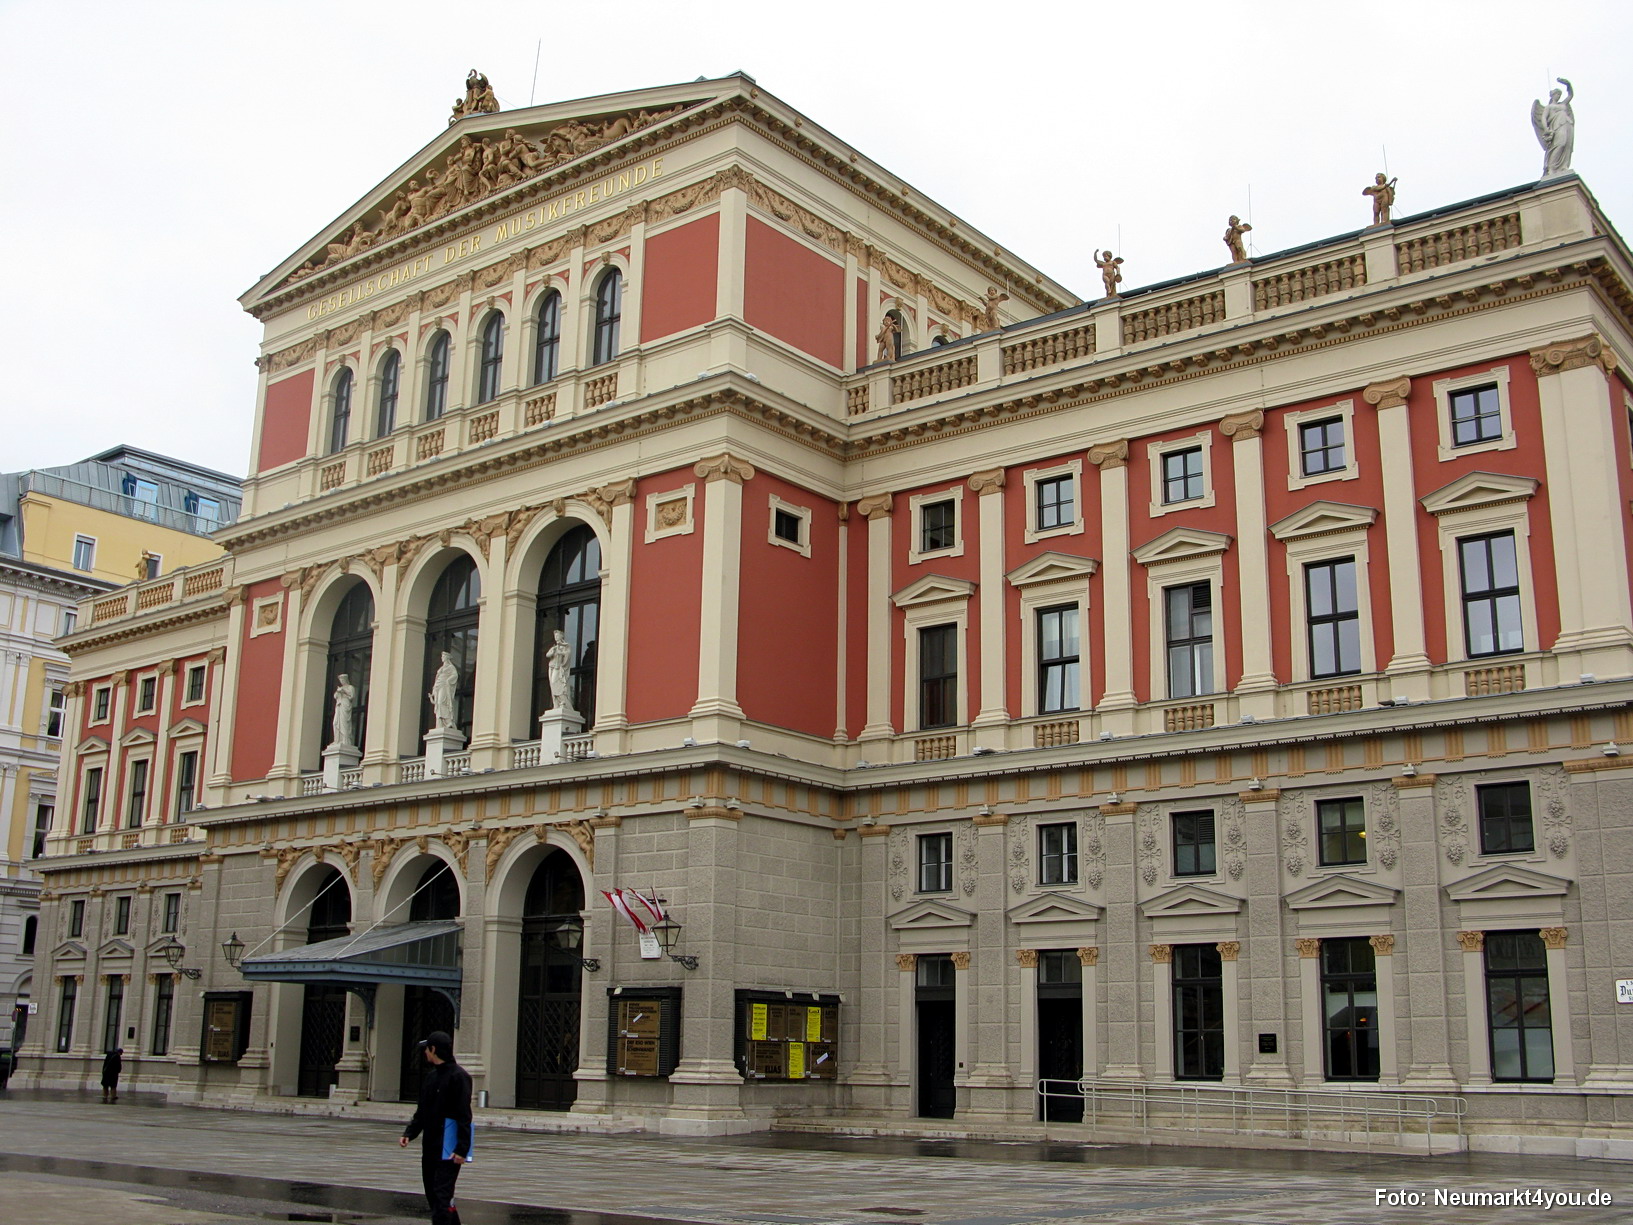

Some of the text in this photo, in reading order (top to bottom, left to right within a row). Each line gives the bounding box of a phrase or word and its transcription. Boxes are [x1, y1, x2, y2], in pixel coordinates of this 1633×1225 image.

[307, 157, 664, 321] GESELLSCHAFT DER MUSIKFREUNDE
[1619, 985, 1633, 996] Du
